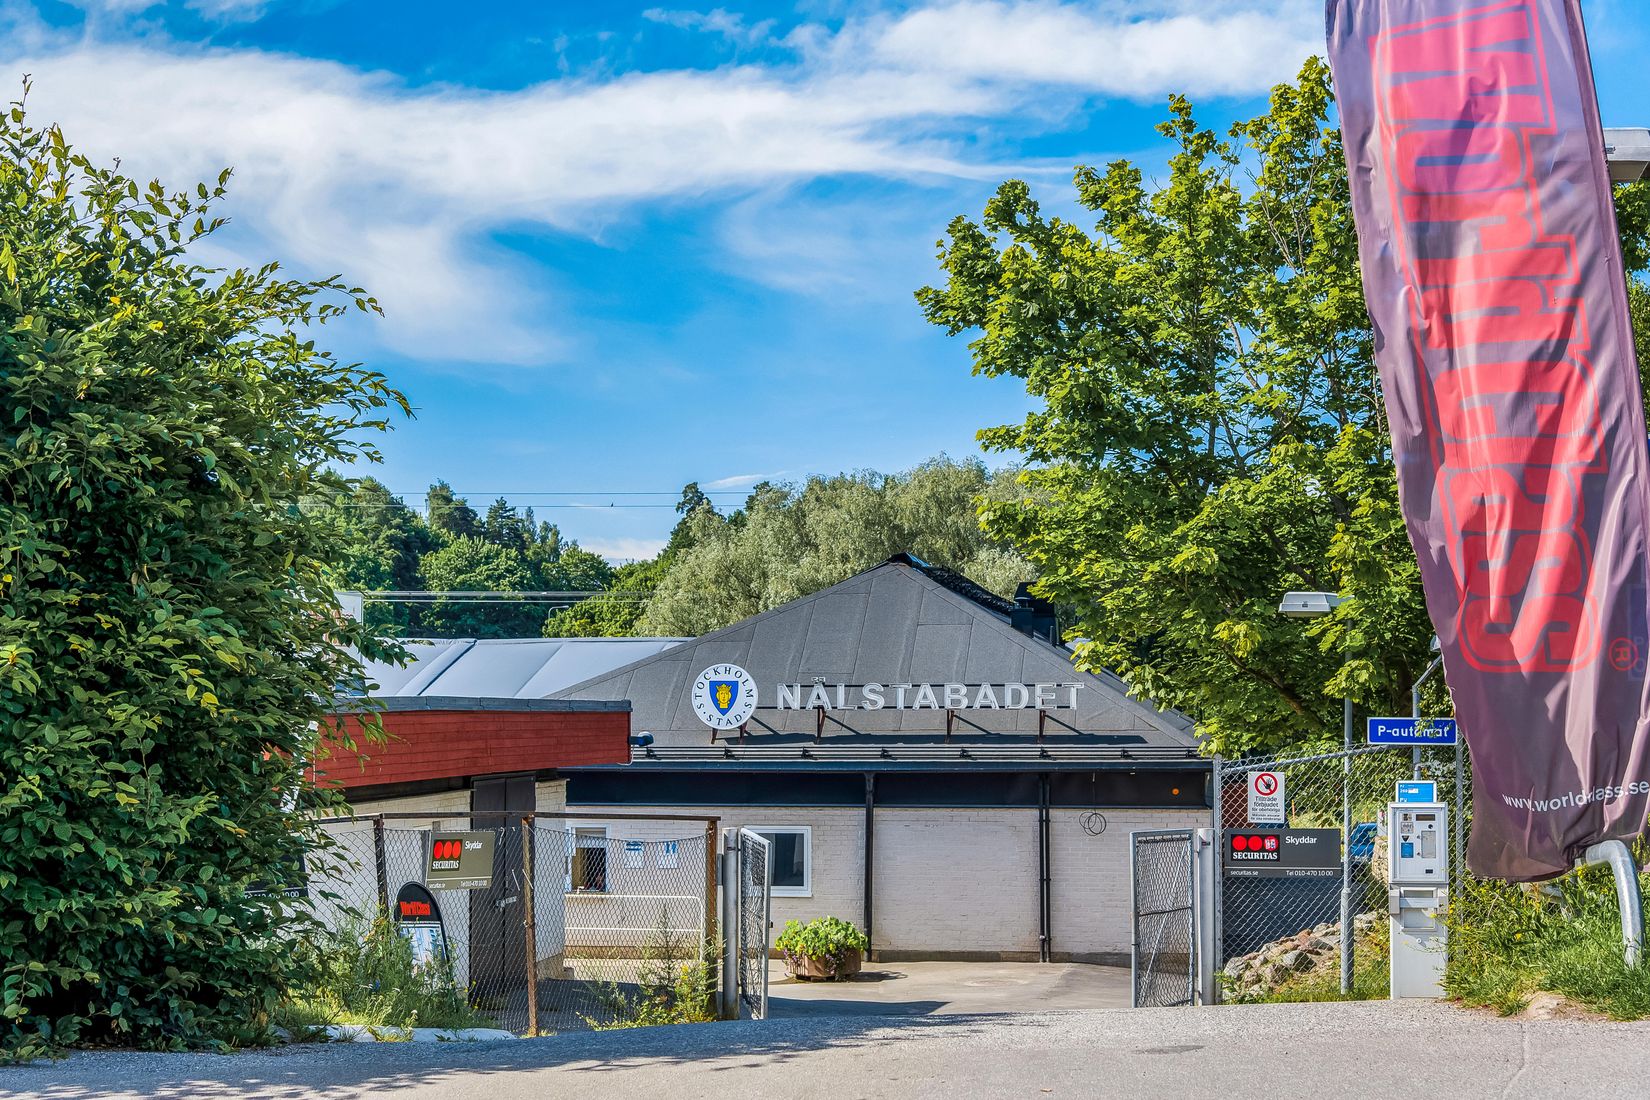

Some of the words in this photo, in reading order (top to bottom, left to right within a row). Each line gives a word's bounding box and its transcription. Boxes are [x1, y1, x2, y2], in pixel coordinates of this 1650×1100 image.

[694, 666, 754, 710] STOCKHOLMS
[776, 676, 1085, 711] NÄLSTABADET
[706, 713, 743, 726] STAD
[1285, 835, 1317, 845] Skyddar
[1232, 851, 1278, 860] SECURITAS
[432, 860, 460, 870] SECURITAS
